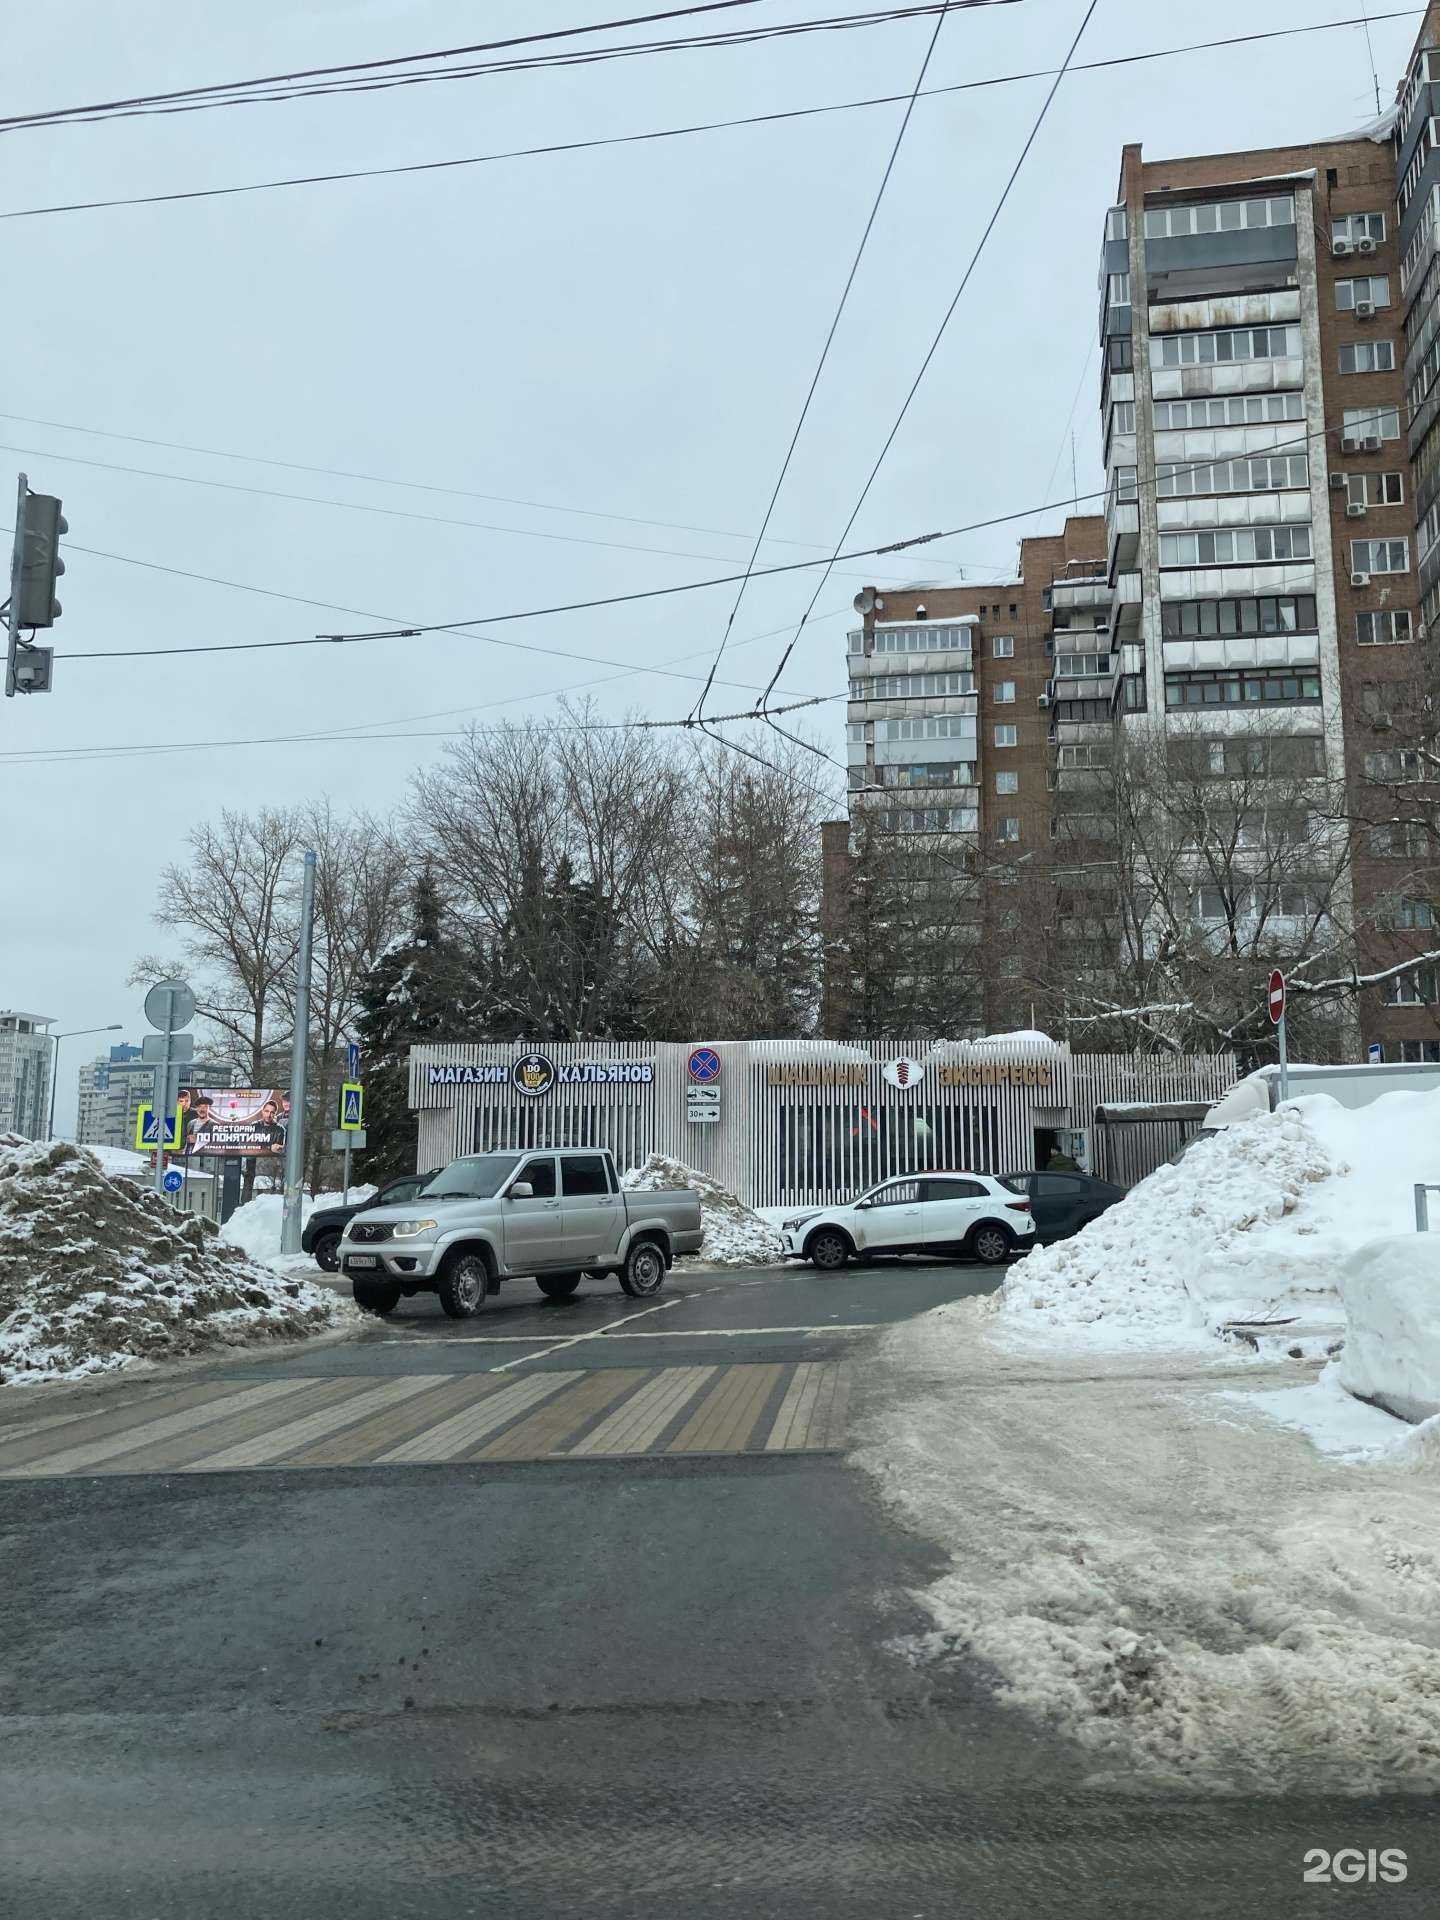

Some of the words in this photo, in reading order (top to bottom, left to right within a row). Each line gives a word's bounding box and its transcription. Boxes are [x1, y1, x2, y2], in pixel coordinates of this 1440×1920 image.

[429, 1067, 508, 1083] МАГАЗИН
[558, 1066, 653, 1083] КАЛЬЯНОВ
[768, 1064, 868, 1086] ШАШЛЫК
[938, 1065, 1052, 1086] ЭКСПРЕСС
[212, 1125, 256, 1133] РЕСТОРАН
[197, 1132, 211, 1143] ПО
[212, 1132, 271, 1143] ПОНЯТИЯМ
